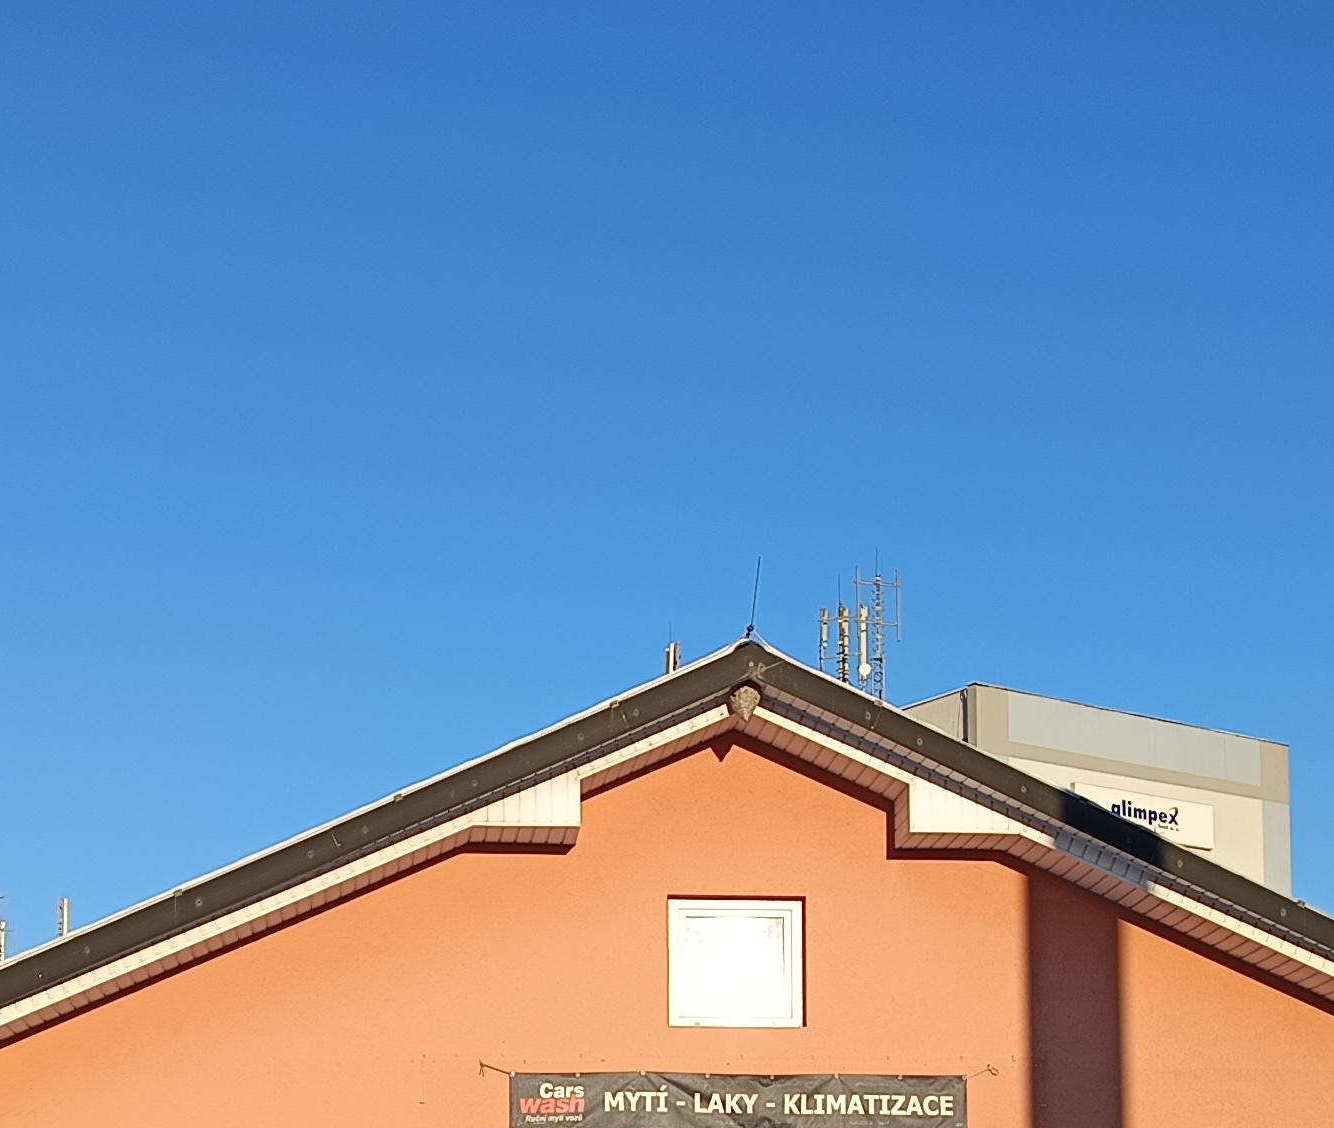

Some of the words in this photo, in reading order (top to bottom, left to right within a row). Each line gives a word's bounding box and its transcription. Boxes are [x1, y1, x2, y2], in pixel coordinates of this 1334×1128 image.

[540, 1082, 585, 1099] Cars
[520, 1094, 586, 1114] wash
[604, 1085, 668, 1113] MYTÍ
[694, 1093, 759, 1115] LAKY
[784, 1094, 955, 1117] KLIMATIZACE
